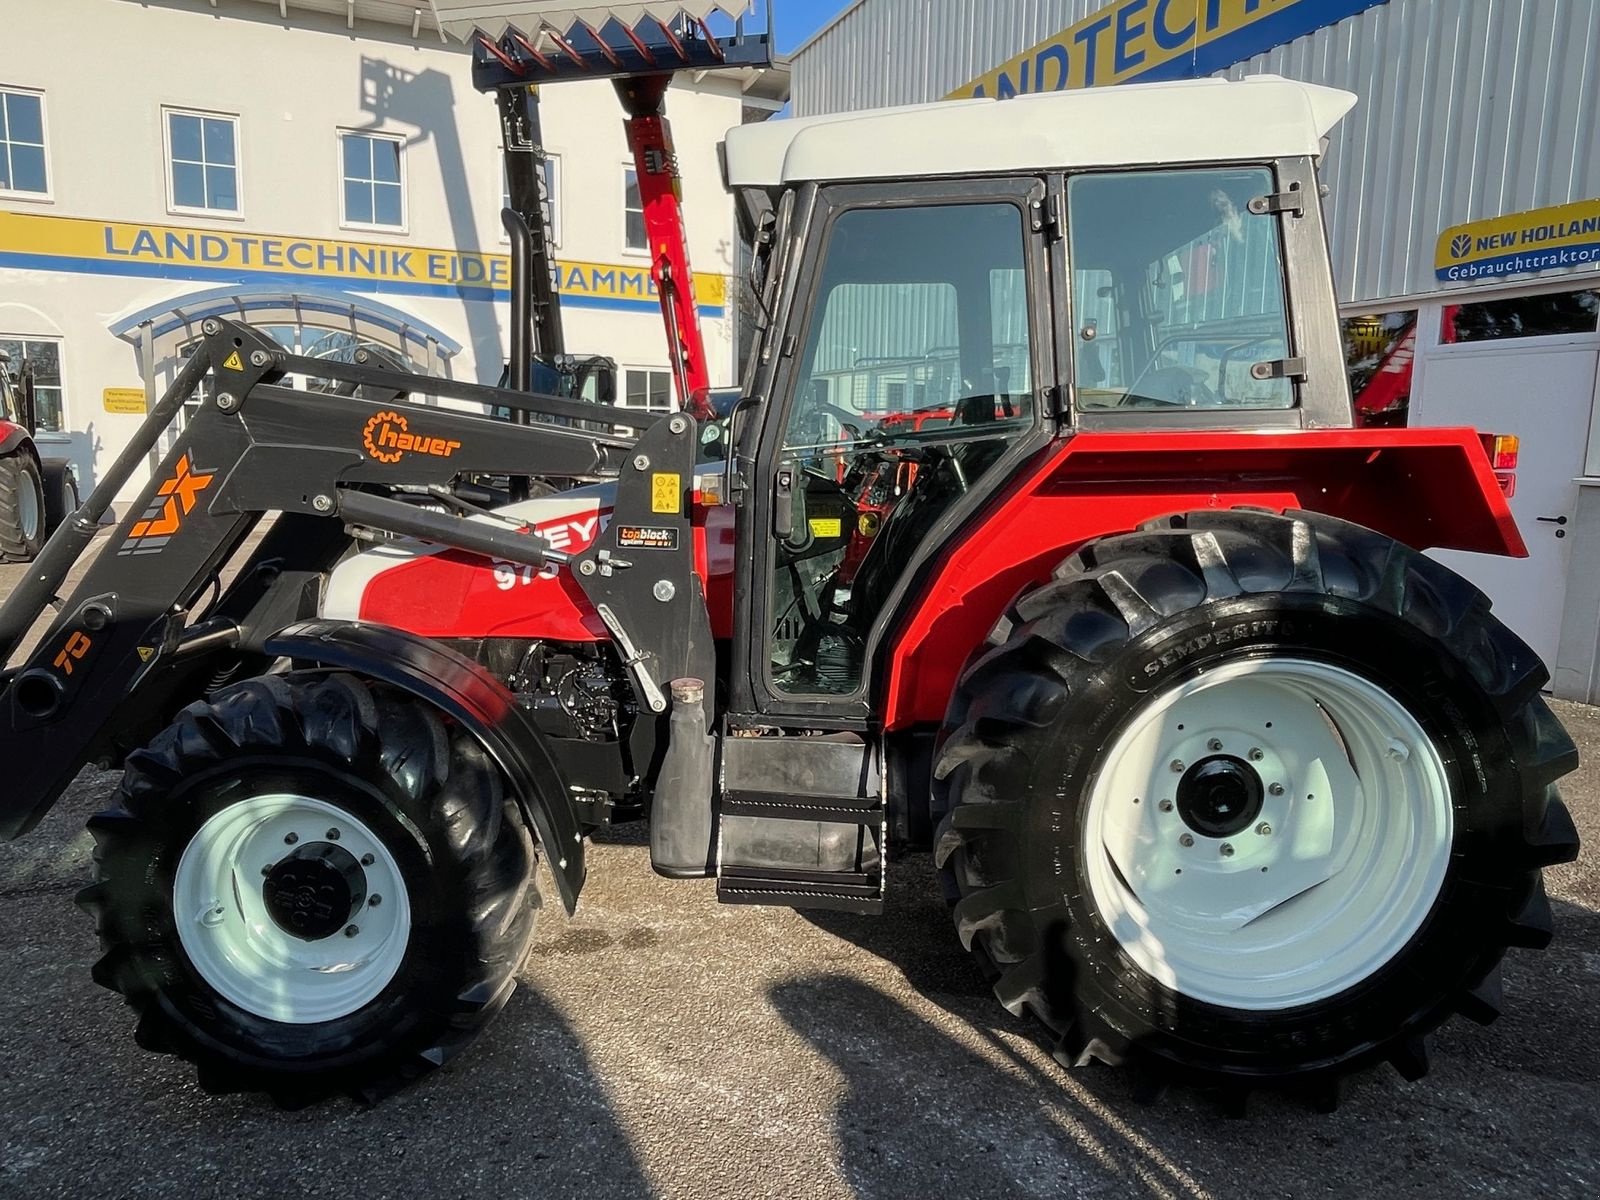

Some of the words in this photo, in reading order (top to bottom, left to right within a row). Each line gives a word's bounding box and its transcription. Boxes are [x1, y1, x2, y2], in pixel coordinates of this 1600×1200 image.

[104, 226, 415, 277] LANDTECHNIK
[1476, 230, 1517, 252] NEW
[1521, 215, 1600, 244] HOLLAN
[1448, 248, 1600, 279] Gebrauchttraktor
[378, 423, 461, 457] hauer
[622, 528, 669, 540] topblock
[53, 631, 92, 675] 70
[1144, 620, 1278, 677] SEMPERIT
